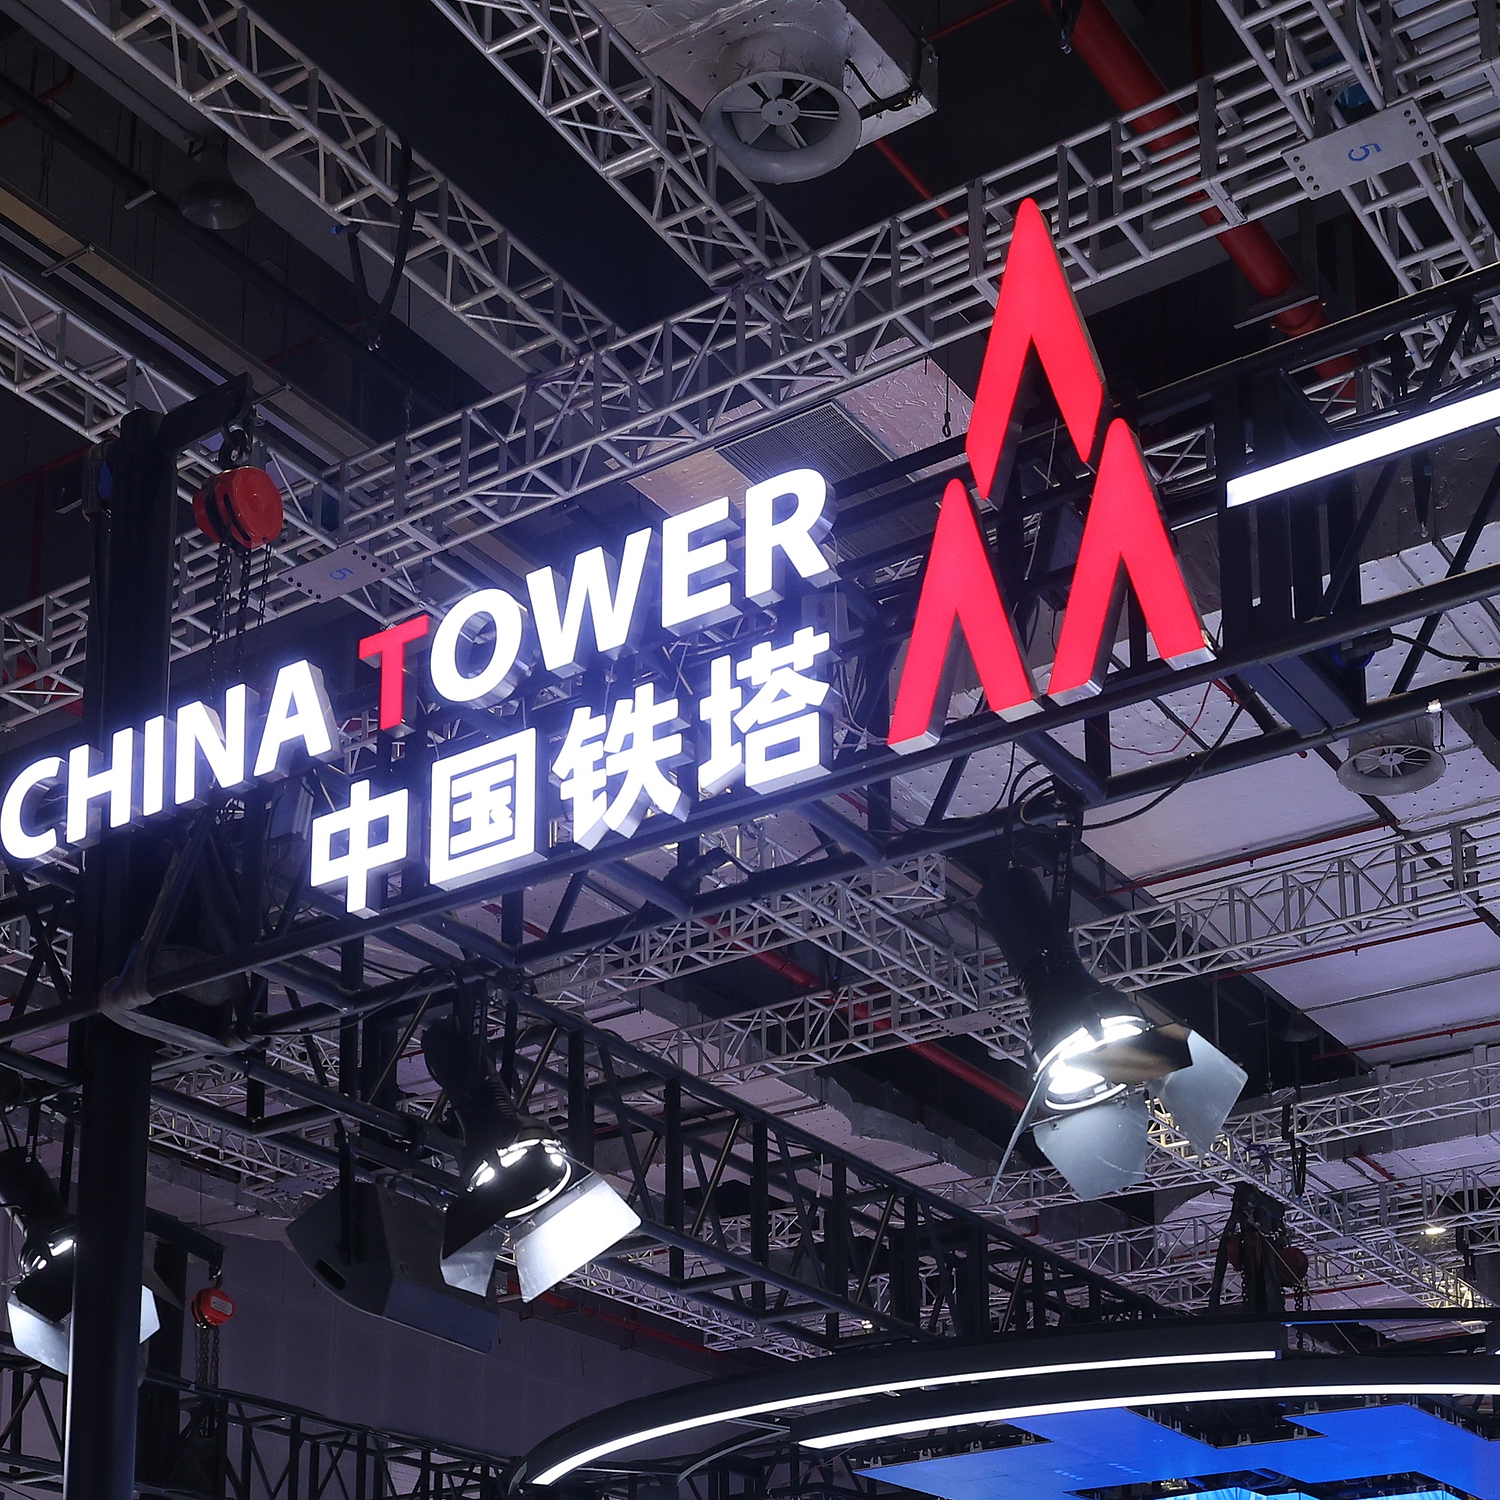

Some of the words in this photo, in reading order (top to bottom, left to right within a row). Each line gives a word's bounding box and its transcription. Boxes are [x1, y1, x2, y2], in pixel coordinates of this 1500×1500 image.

[359, 467, 832, 732] TOWER
[310, 626, 831, 916] 中国铁塔
